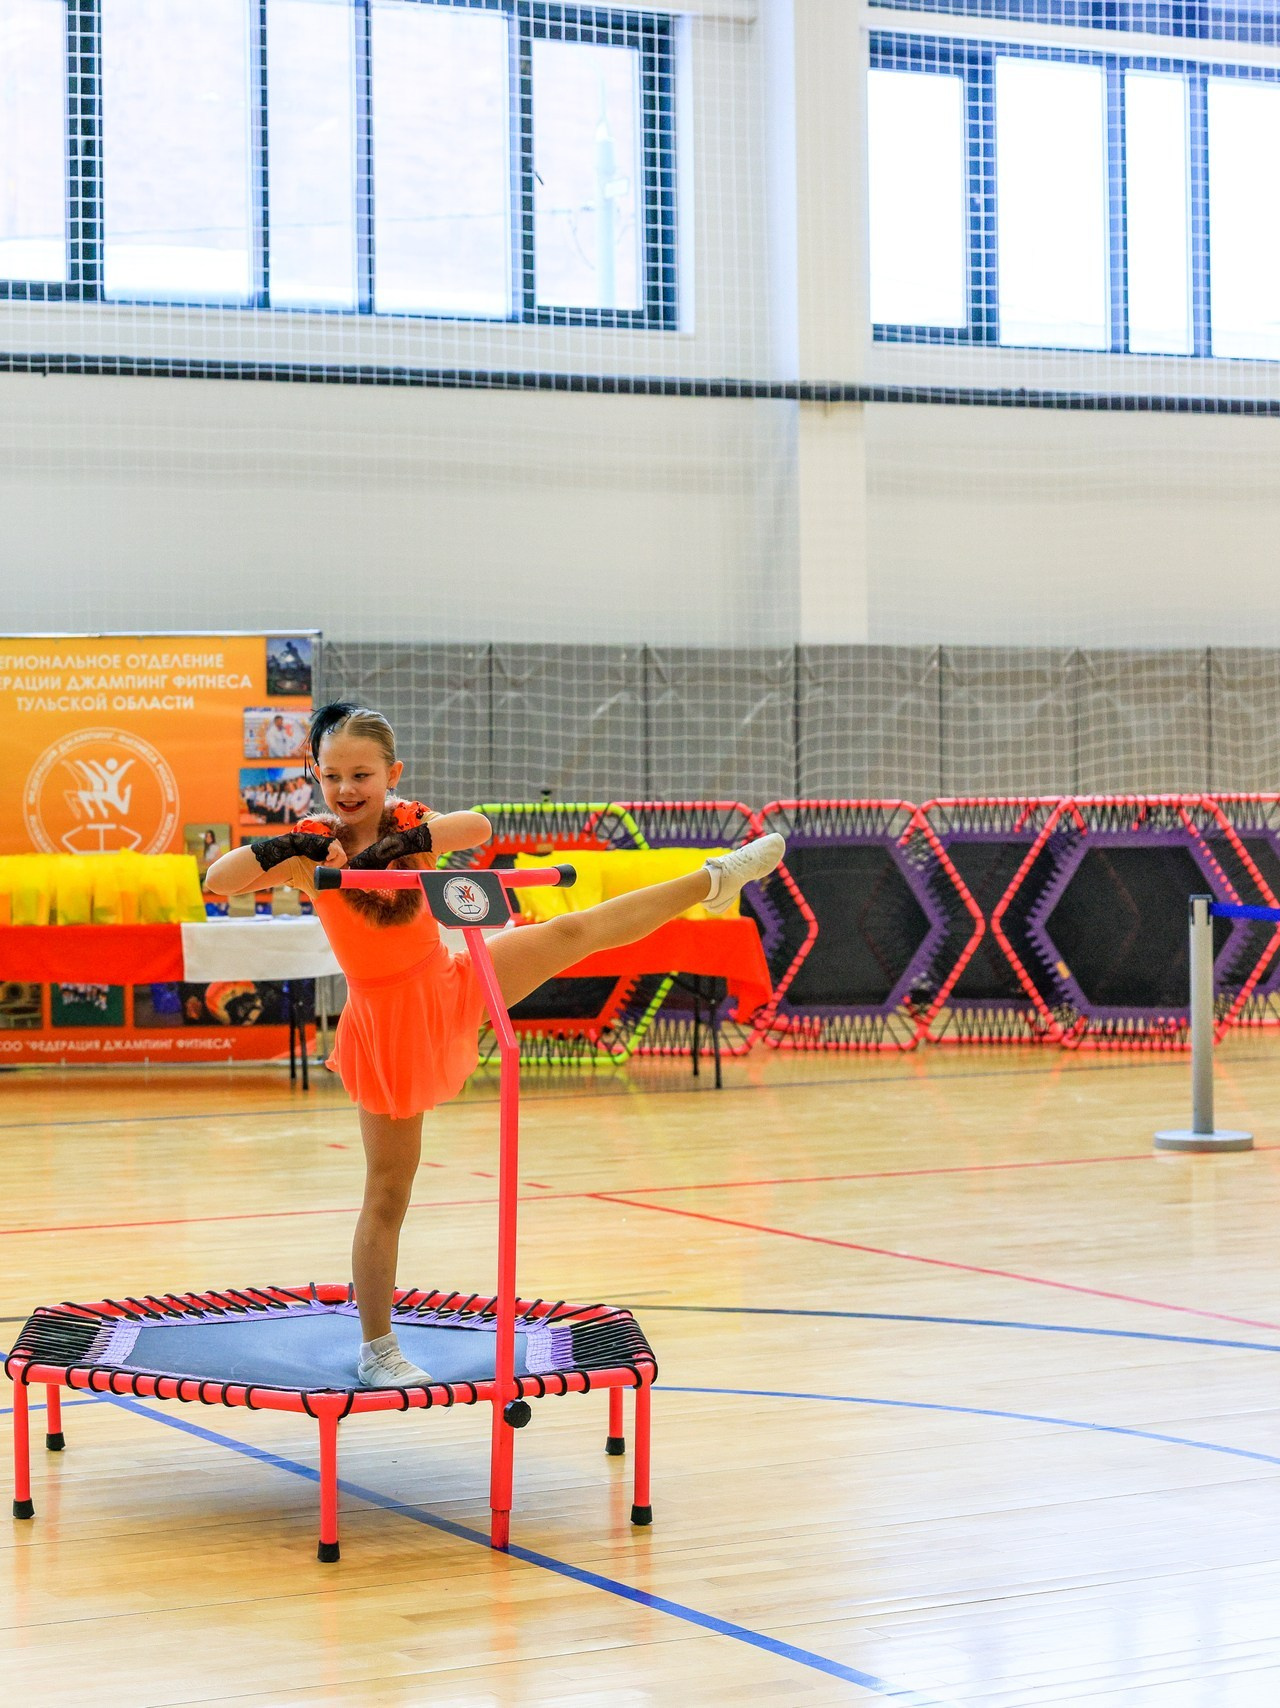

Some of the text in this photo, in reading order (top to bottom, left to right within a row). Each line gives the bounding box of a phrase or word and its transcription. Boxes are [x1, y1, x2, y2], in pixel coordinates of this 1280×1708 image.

[125, 653, 224, 669] ОТДЕЛЕНИЕ
[66, 674, 167, 691] ДЖАМПИНГ
[172, 673, 253, 689] ФИТНЕСА
[16, 693, 194, 712] ТУЛЬСКОЙ ОБЛАСТИ
